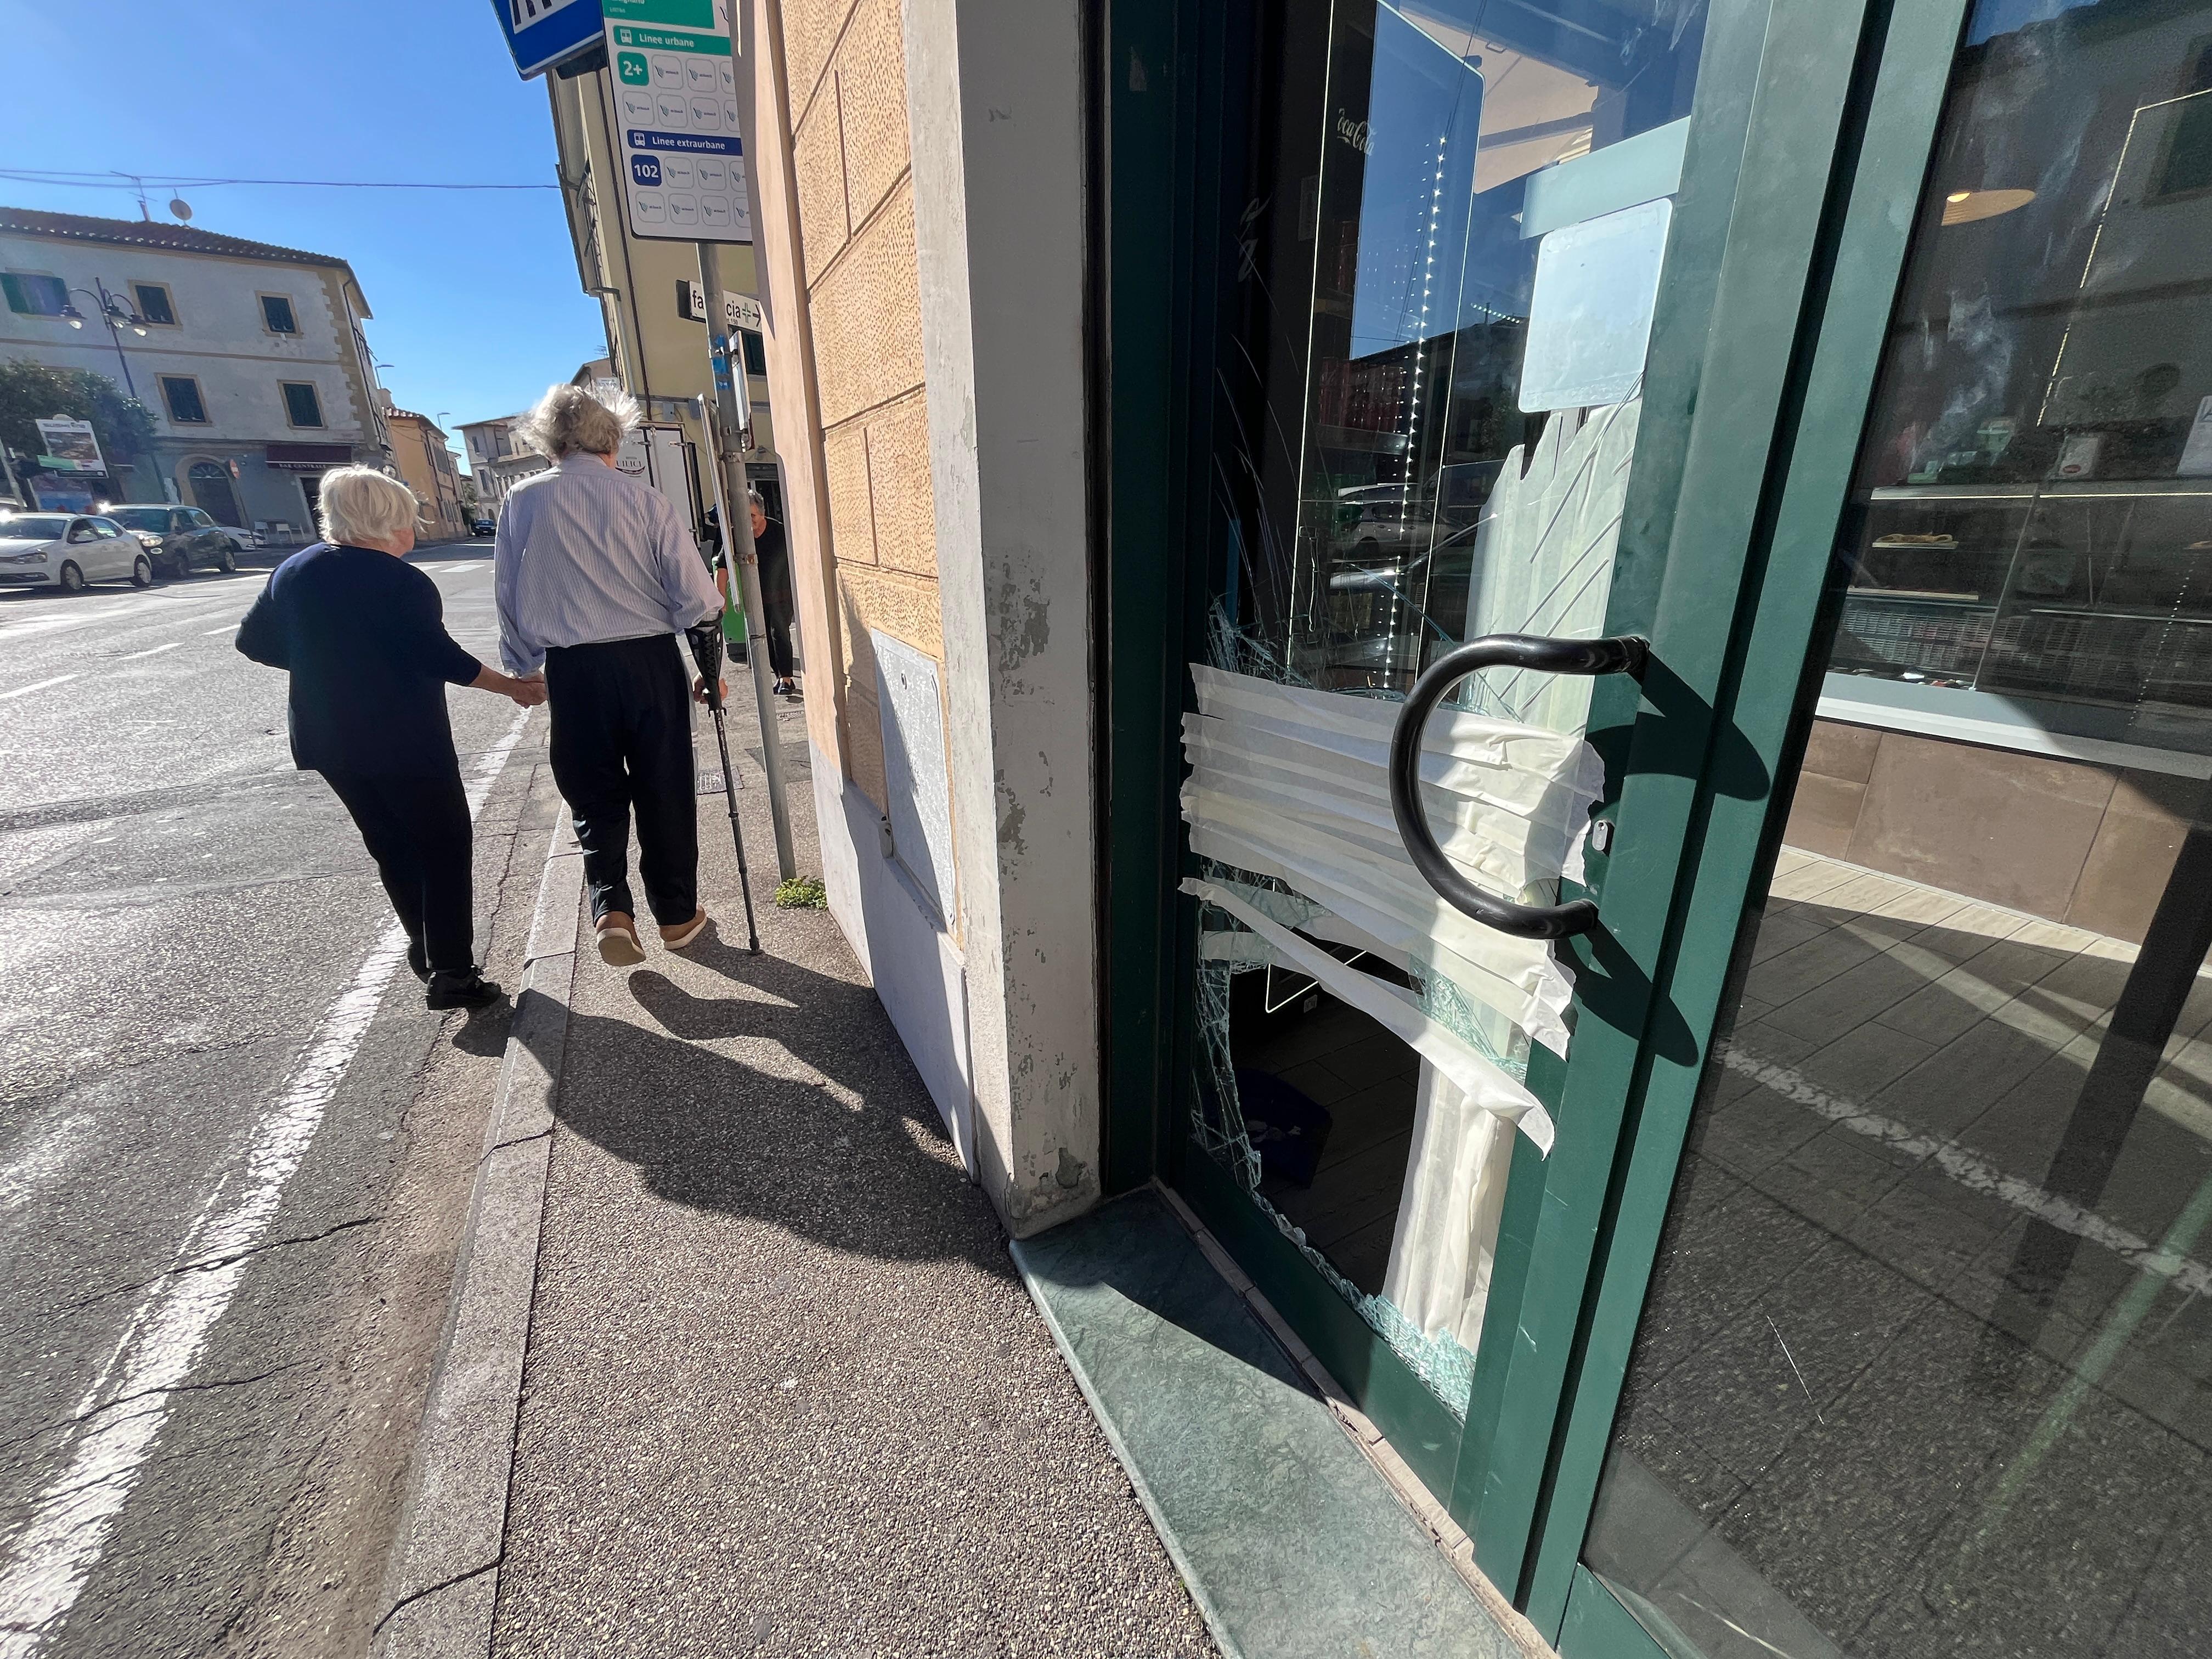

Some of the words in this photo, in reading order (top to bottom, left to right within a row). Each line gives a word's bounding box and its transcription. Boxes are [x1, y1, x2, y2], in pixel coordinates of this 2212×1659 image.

[639, 33, 663, 44] Linee
[664, 37, 695, 48] urbane
[623, 60, 643, 76] 2+
[652, 136, 675, 146] Linee
[676, 140, 726, 150] extraurbane
[634, 164, 659, 178] 102
[692, 290, 741, 319] facia
